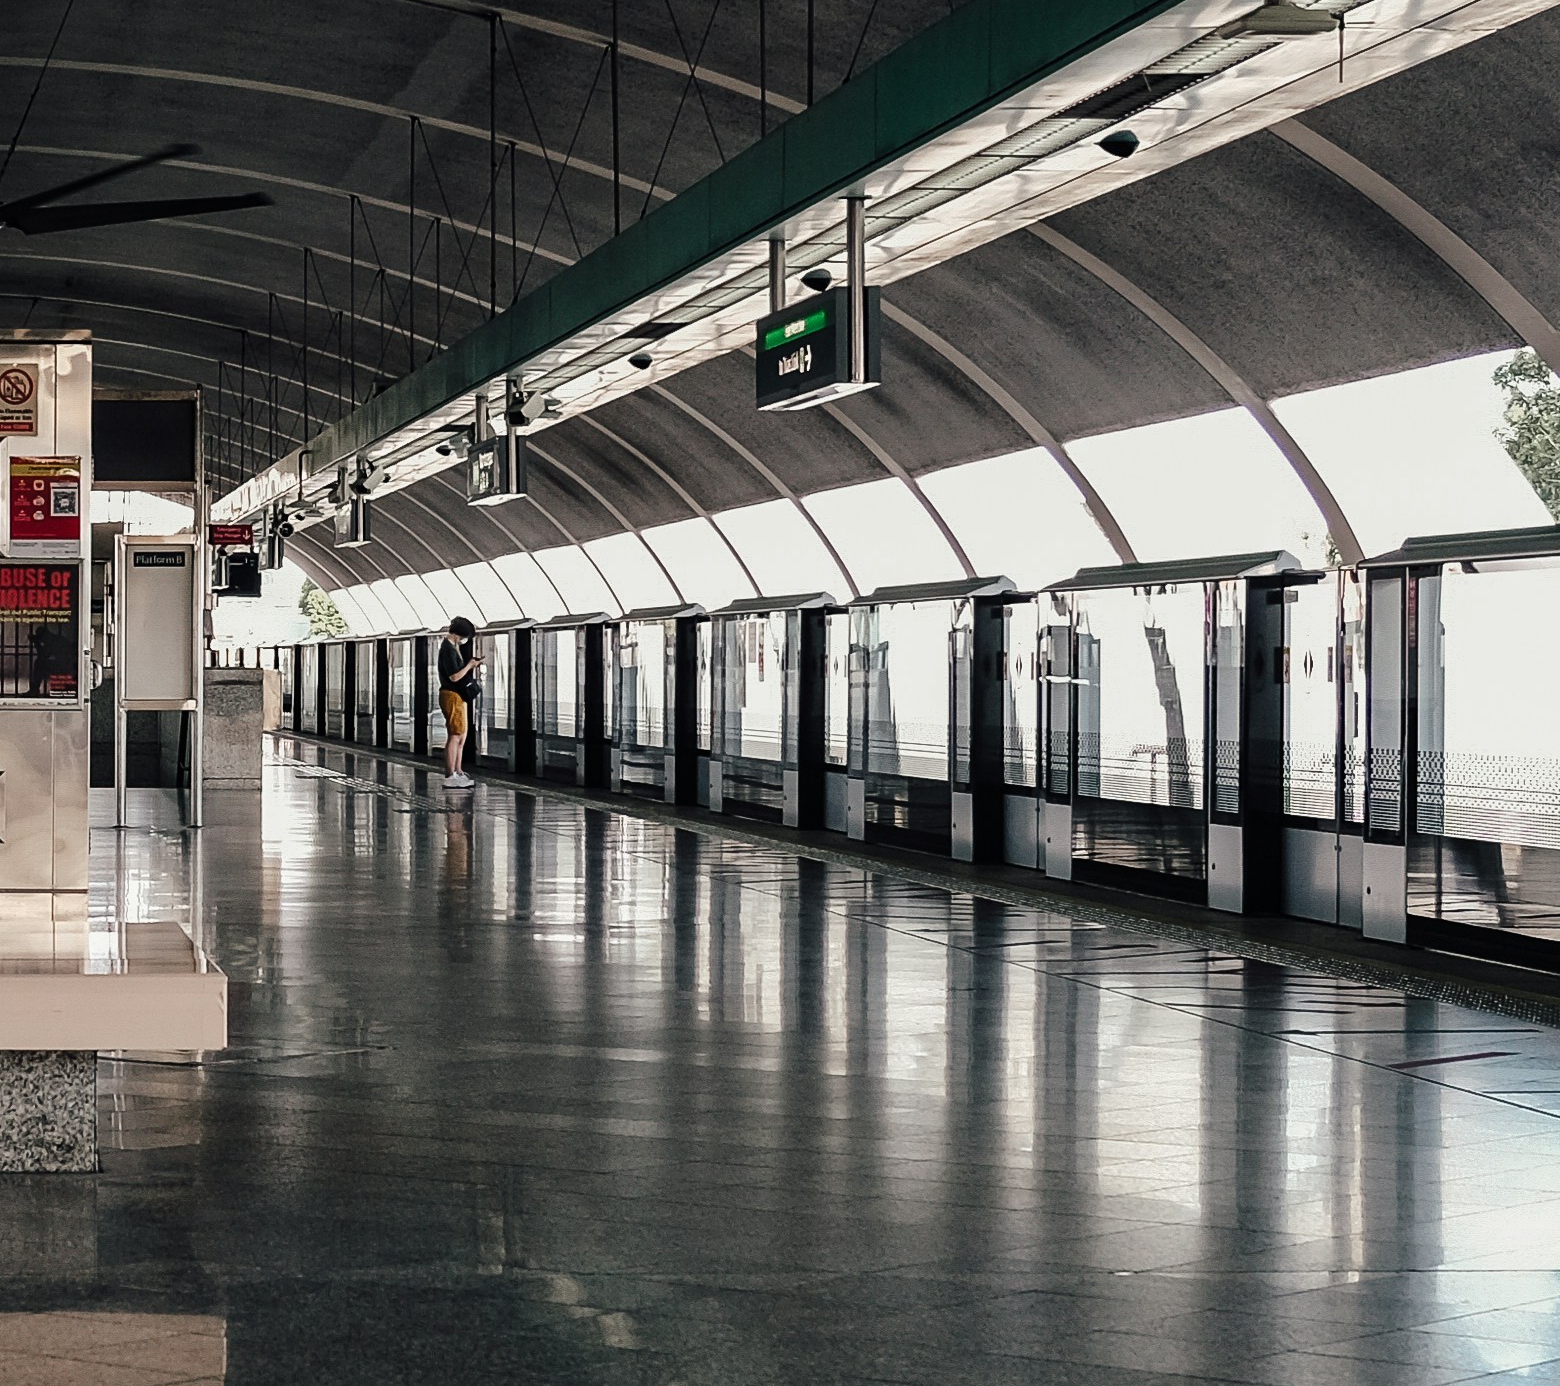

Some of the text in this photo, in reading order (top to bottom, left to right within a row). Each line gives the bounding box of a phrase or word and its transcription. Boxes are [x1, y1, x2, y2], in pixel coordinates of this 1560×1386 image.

[136, 555, 183, 564] Platform B
[51, 571, 71, 586] or
